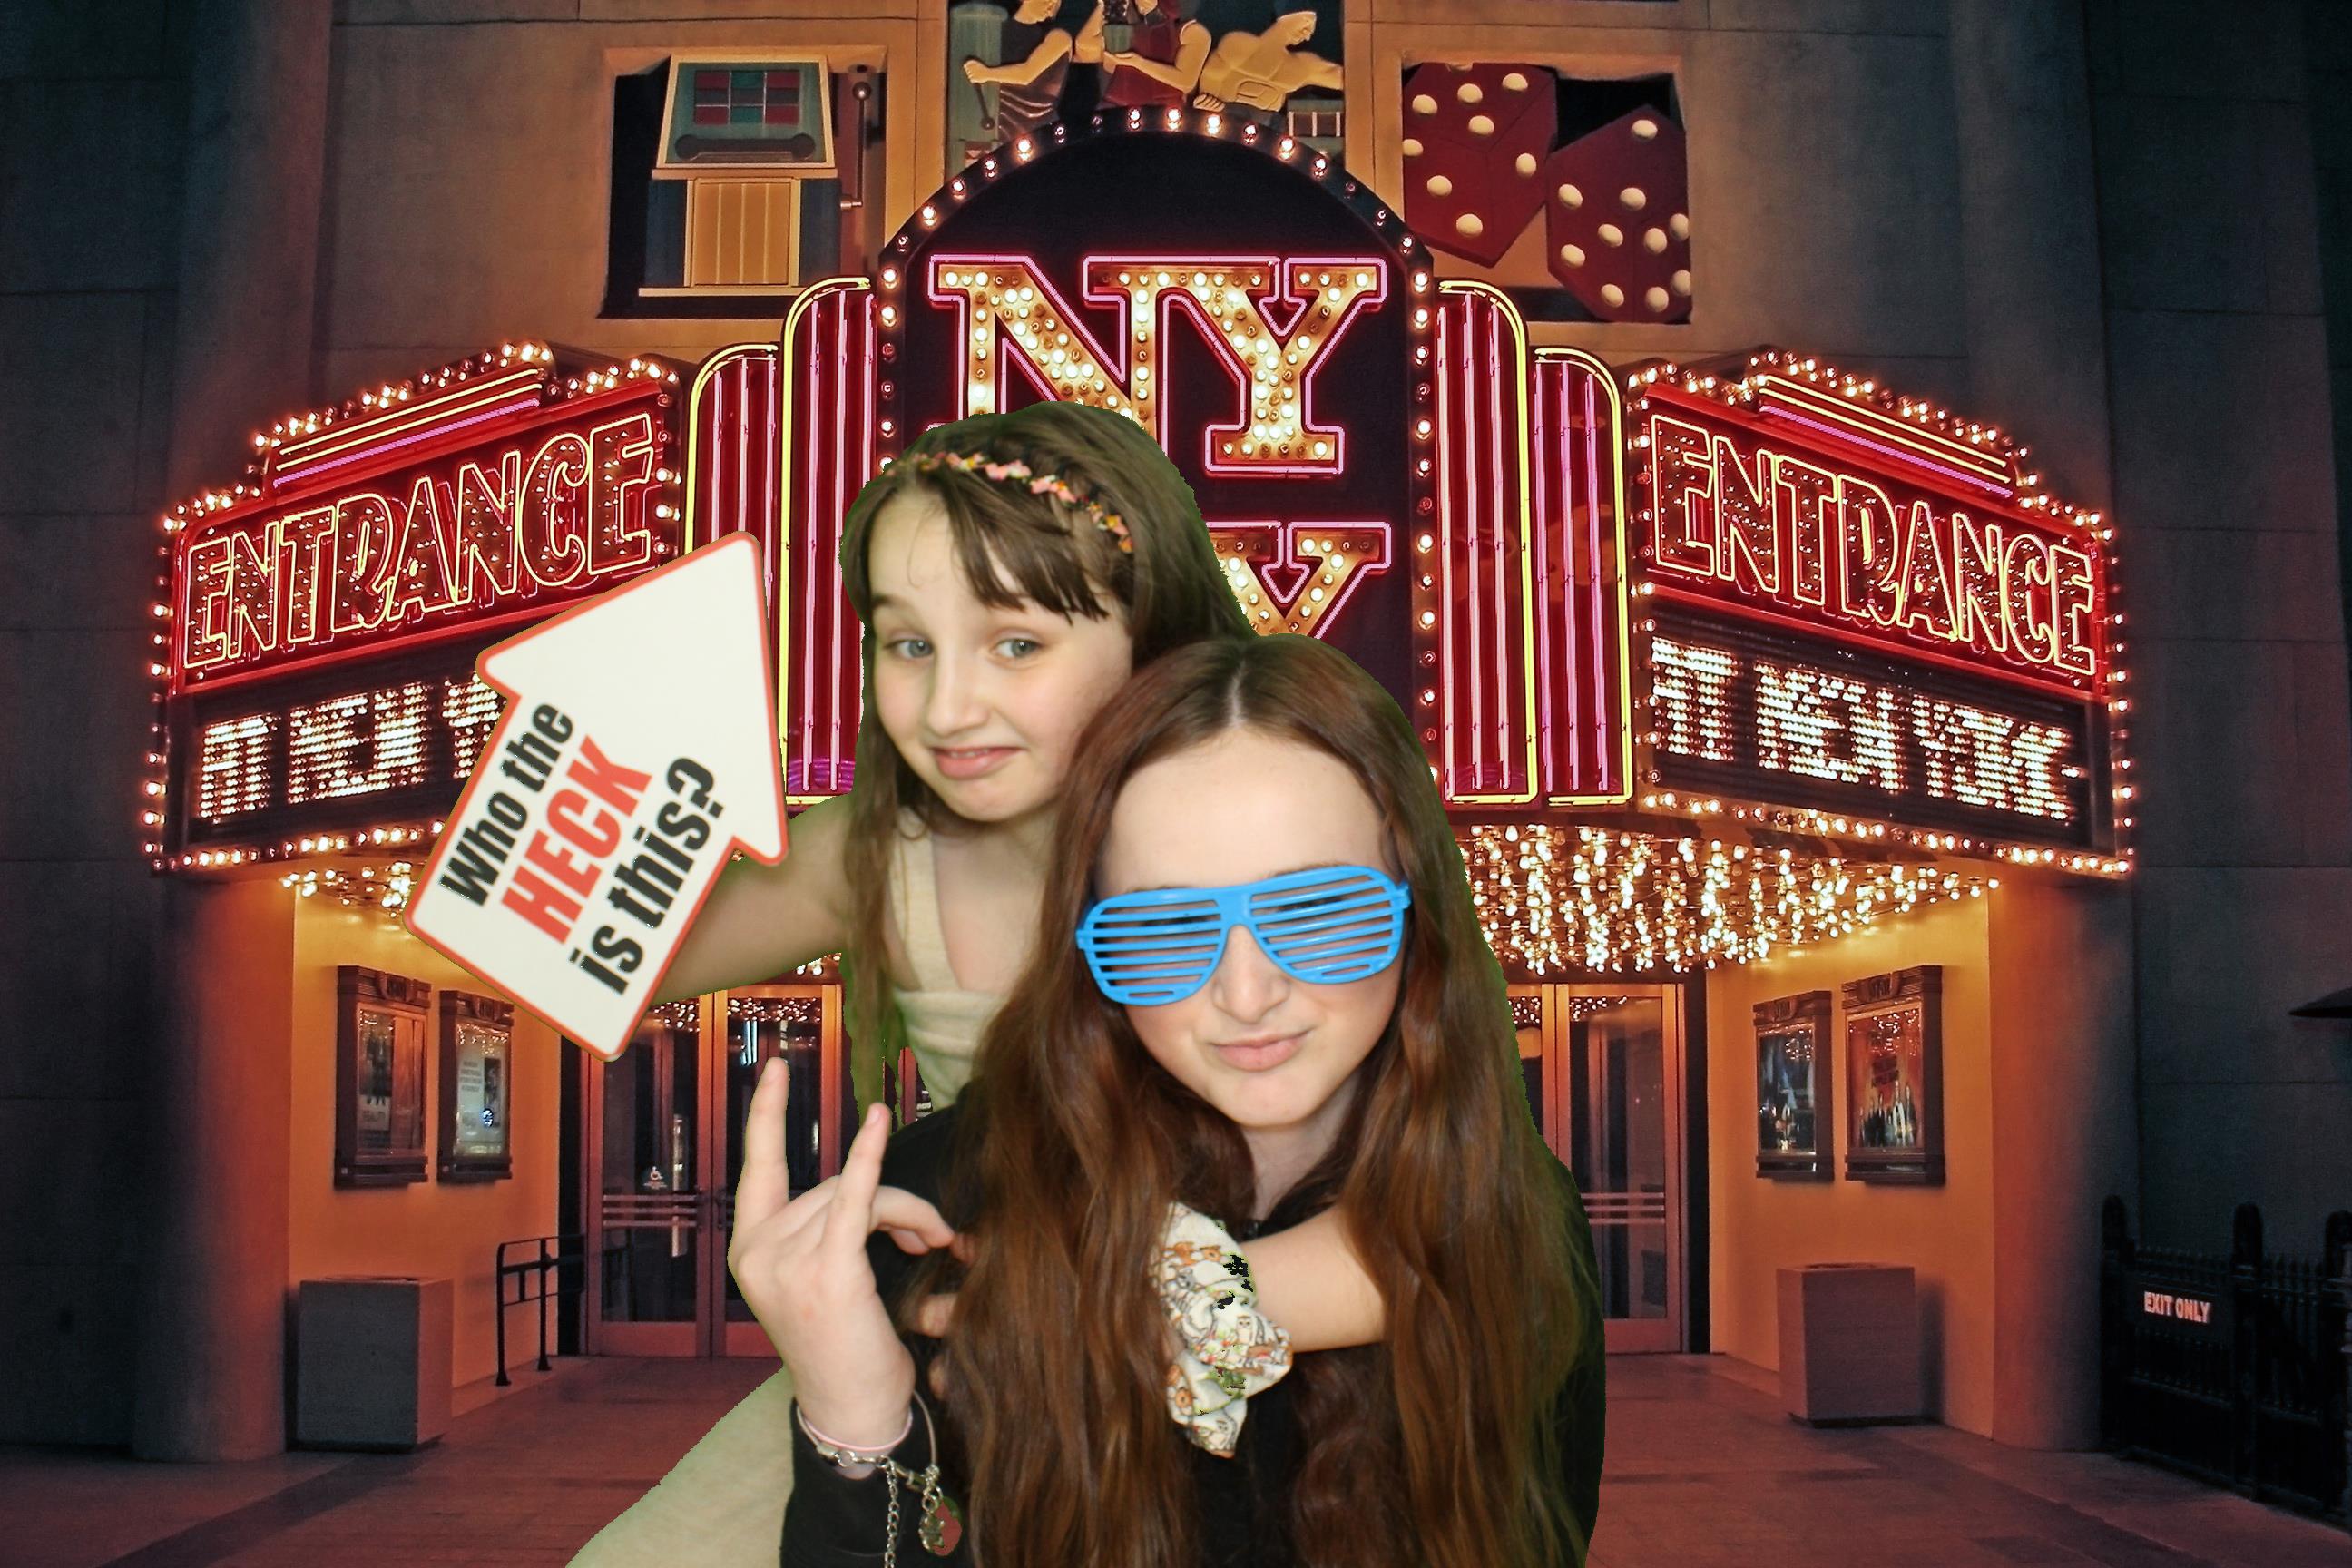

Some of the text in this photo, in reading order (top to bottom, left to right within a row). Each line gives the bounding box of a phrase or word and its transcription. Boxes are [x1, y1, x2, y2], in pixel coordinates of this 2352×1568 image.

[929, 255, 1387, 475] NY
[184, 413, 655, 669] ENTRANCE
[1650, 415, 2096, 674] ENTRANCE
[440, 703, 573, 906] Who the
[502, 735, 652, 945] HECK
[569, 757, 724, 995] is this?
[2144, 1290, 2211, 1323] EXIT ONLY
